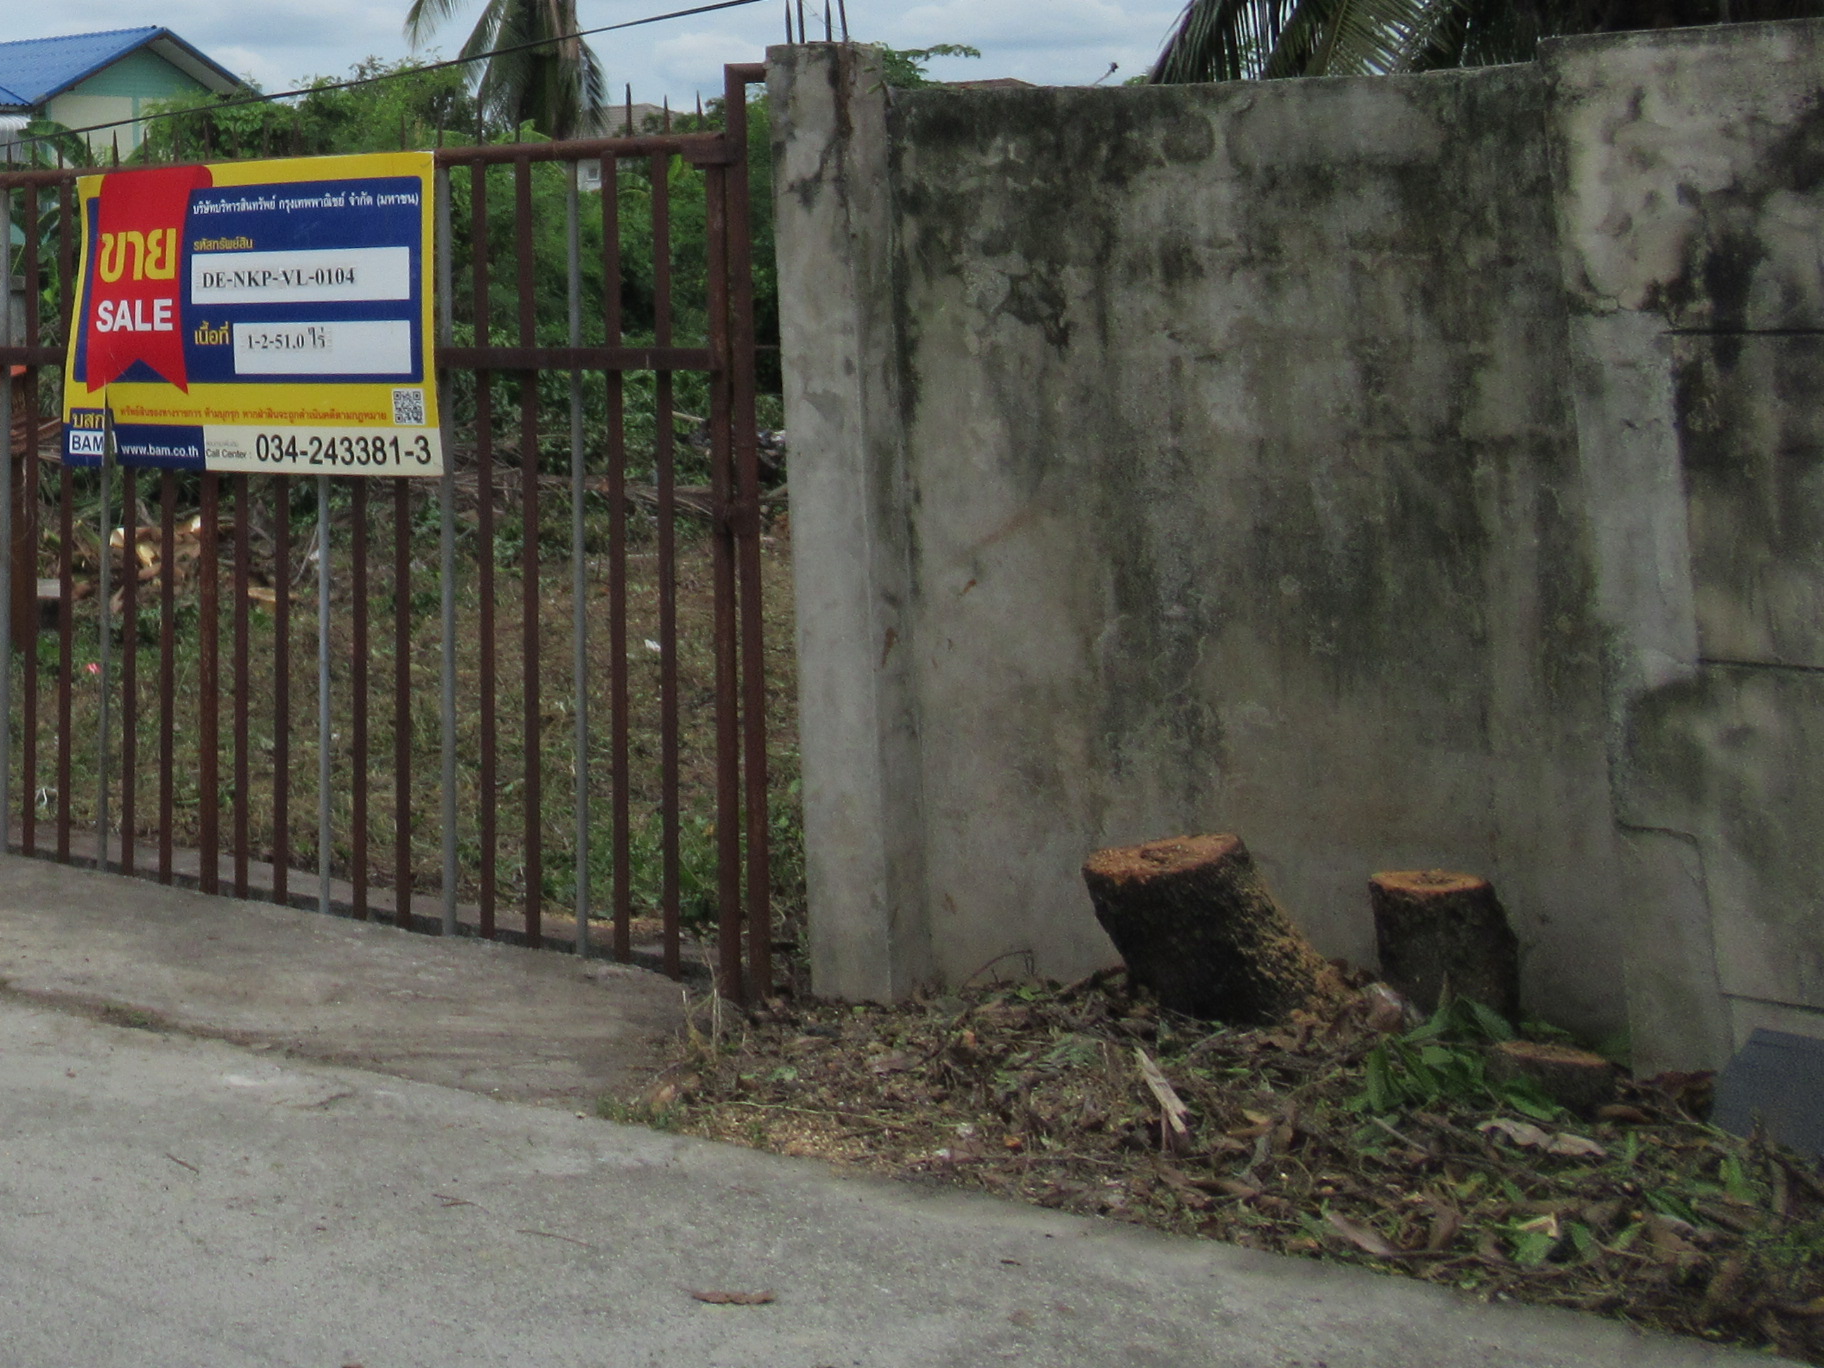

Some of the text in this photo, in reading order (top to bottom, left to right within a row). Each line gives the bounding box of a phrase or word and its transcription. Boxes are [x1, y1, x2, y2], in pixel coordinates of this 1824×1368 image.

[278, 191, 345, 213] กรุงเทพพาณิชย์
[348, 192, 373, 206] จำกัด
[376, 193, 419, 207] (มหาชน)
[193, 236, 254, 251] รหัสทรัพย์สิน
[99, 228, 177, 283] ขาย
[201, 267, 356, 289] DE-NKP-VL-0104
[96, 299, 173, 332] SALE
[194, 320, 230, 346] เนื้อที่
[307, 327, 327, 349] ไร่
[121, 443, 199, 458] www.bam.co.th
[255, 433, 431, 466] 034-243381-3
